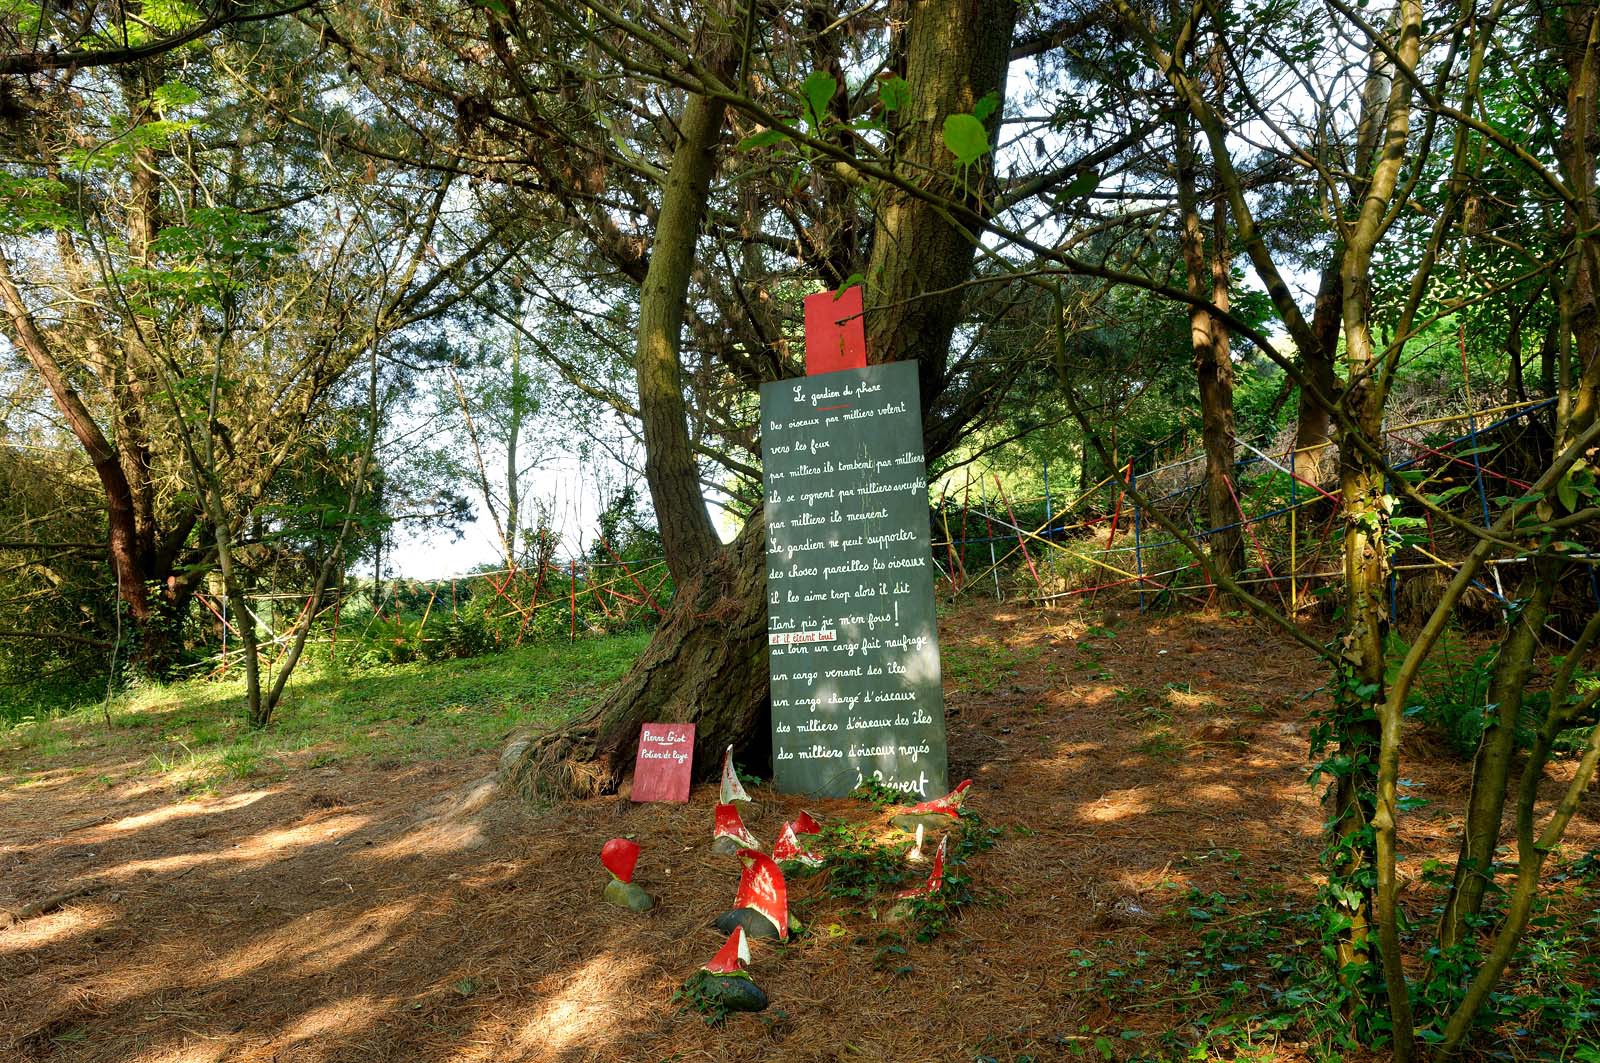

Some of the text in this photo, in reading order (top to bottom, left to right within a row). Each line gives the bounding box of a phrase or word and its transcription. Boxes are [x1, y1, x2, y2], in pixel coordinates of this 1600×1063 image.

[793, 381, 881, 406] Le gardien du phare
[770, 402, 906, 430] Des oiseaux par milliers volent
[770, 439, 830, 454] vers les feux
[769, 452, 925, 482] par milliers ils tombent par milliers
[769, 491, 782, 503] ils
[801, 490, 834, 506] cognent
[838, 489, 855, 502] par
[857, 482, 892, 494] milliers
[893, 477, 926, 495] aveuglés
[769, 508, 888, 534] par milliers ils meurent
[788, 537, 825, 559] gardien
[829, 539, 839, 547] ne
[842, 538, 864, 551] peut
[867, 529, 917, 549] supporter
[769, 556, 925, 580] des choses pareilles les oiseaux
[771, 582, 910, 604] il les aime trop alors il dit
[801, 618, 818, 633] pis
[821, 617, 834, 632] je
[839, 613, 865, 625] m'en
[894, 601, 899, 626] !
[772, 635, 780, 644] et
[783, 634, 791, 643] il
[818, 630, 833, 640] tout
[772, 647, 784, 655] au
[787, 644, 809, 654] loin
[833, 644, 860, 656] cargo
[861, 638, 881, 655] fait
[885, 634, 928, 651] naufrage
[772, 661, 906, 686] un cargo venant des îles
[773, 691, 916, 712] un cargo chargé d'oiseaux
[776, 709, 932, 733] des milliers d'oiseaux des îles
[643, 731, 665, 742] Pierre
[664, 750, 671, 758] de
[777, 739, 929, 762] des milliers d'oiseaux noyés
